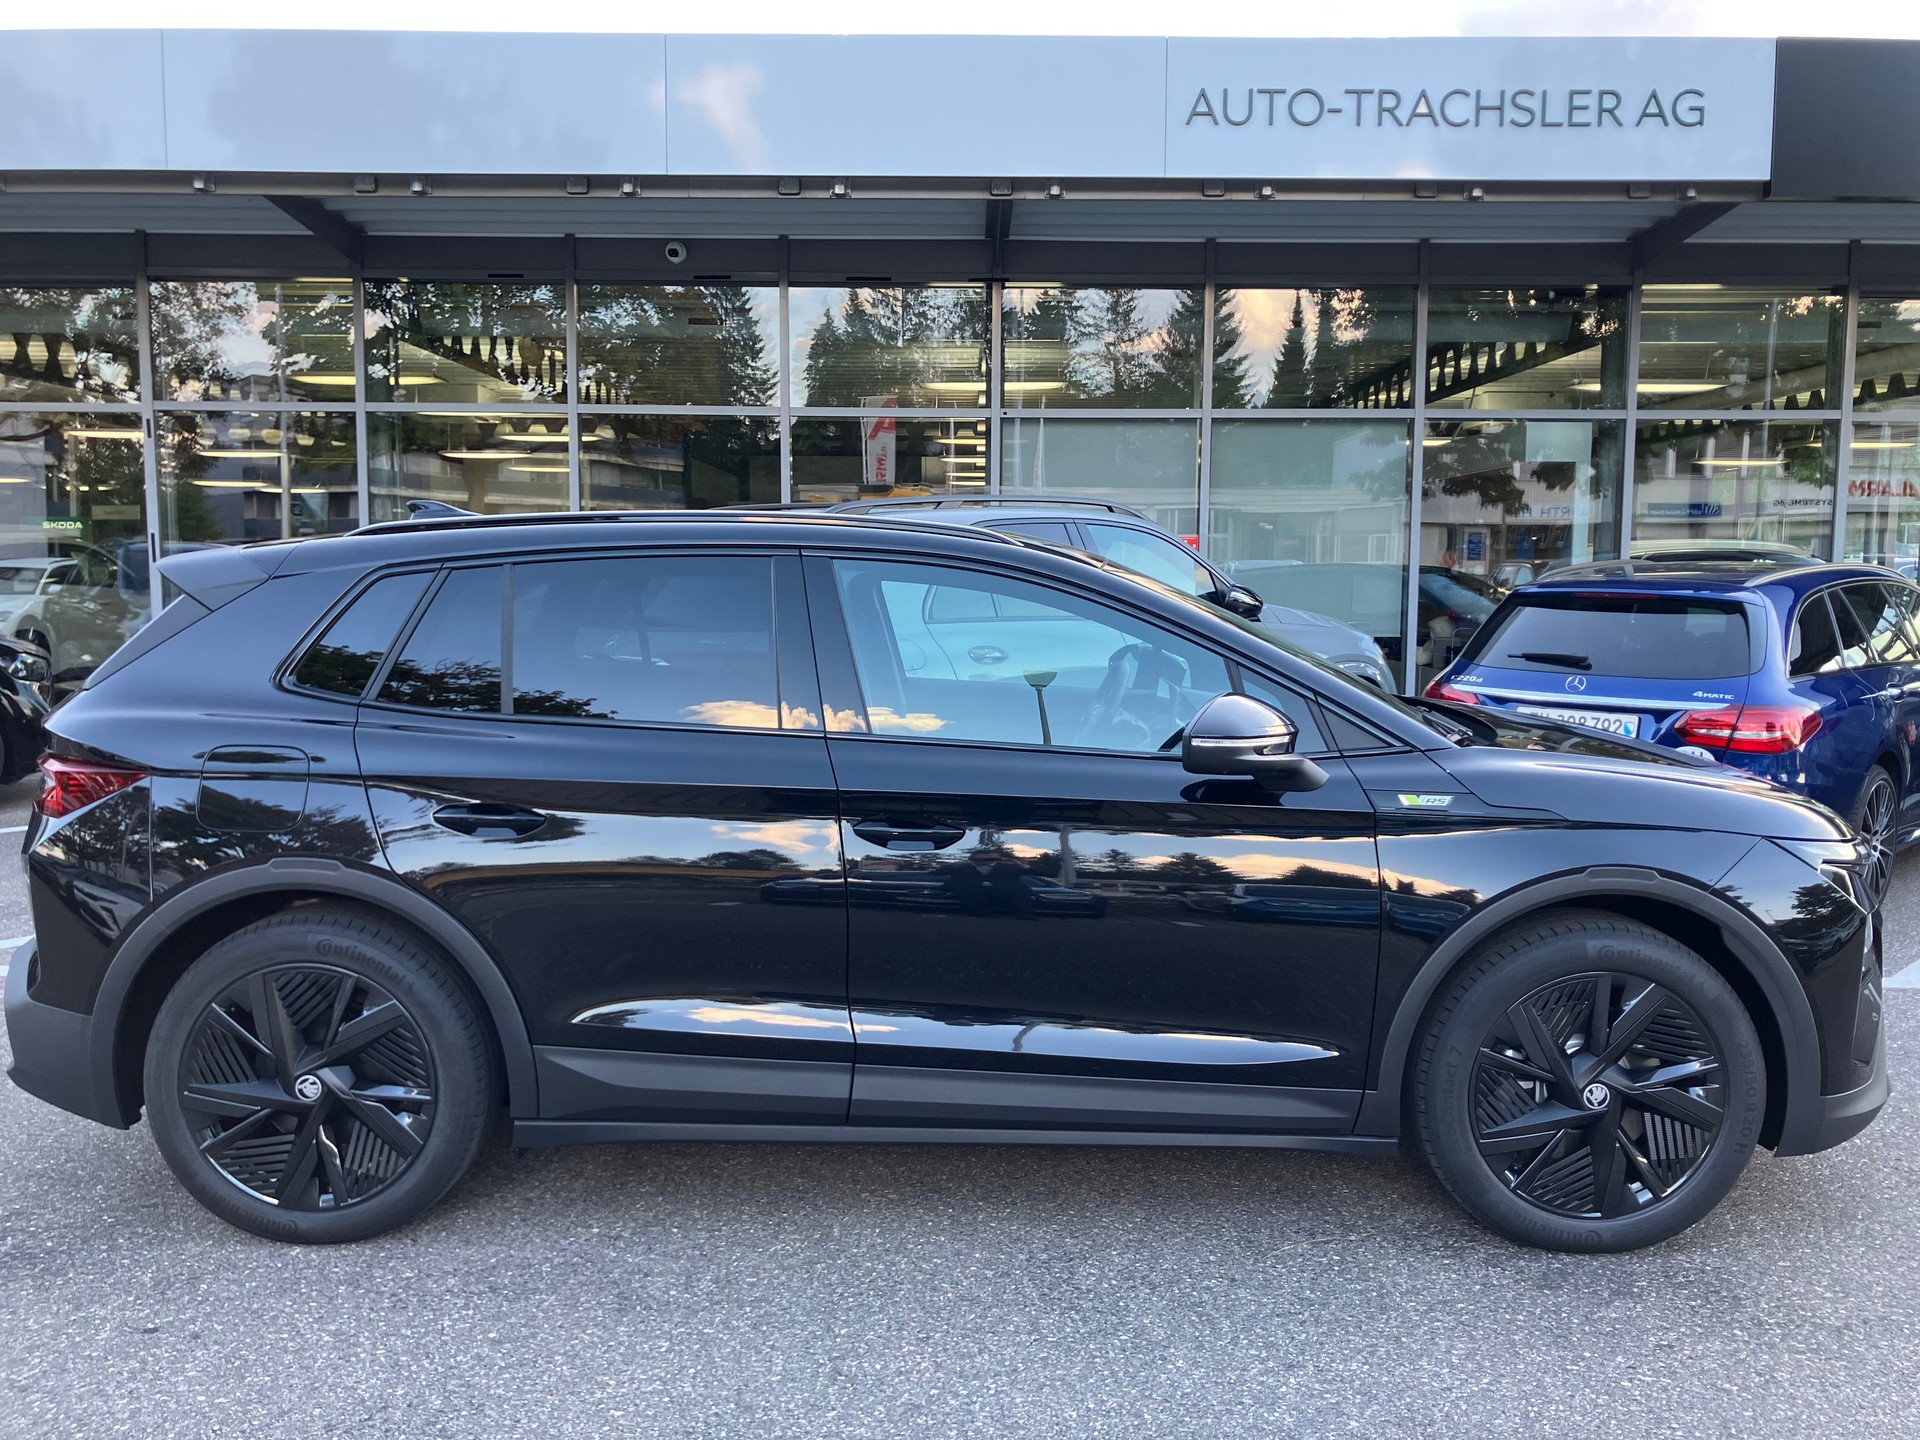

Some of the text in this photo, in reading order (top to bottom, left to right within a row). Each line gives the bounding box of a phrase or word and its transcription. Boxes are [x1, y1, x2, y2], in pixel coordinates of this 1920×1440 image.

[1186, 87, 1706, 127] AUTO-TRACHSLER AG
[1692, 690, 1735, 700] 4MATIC
[316, 938, 408, 986] Continental
